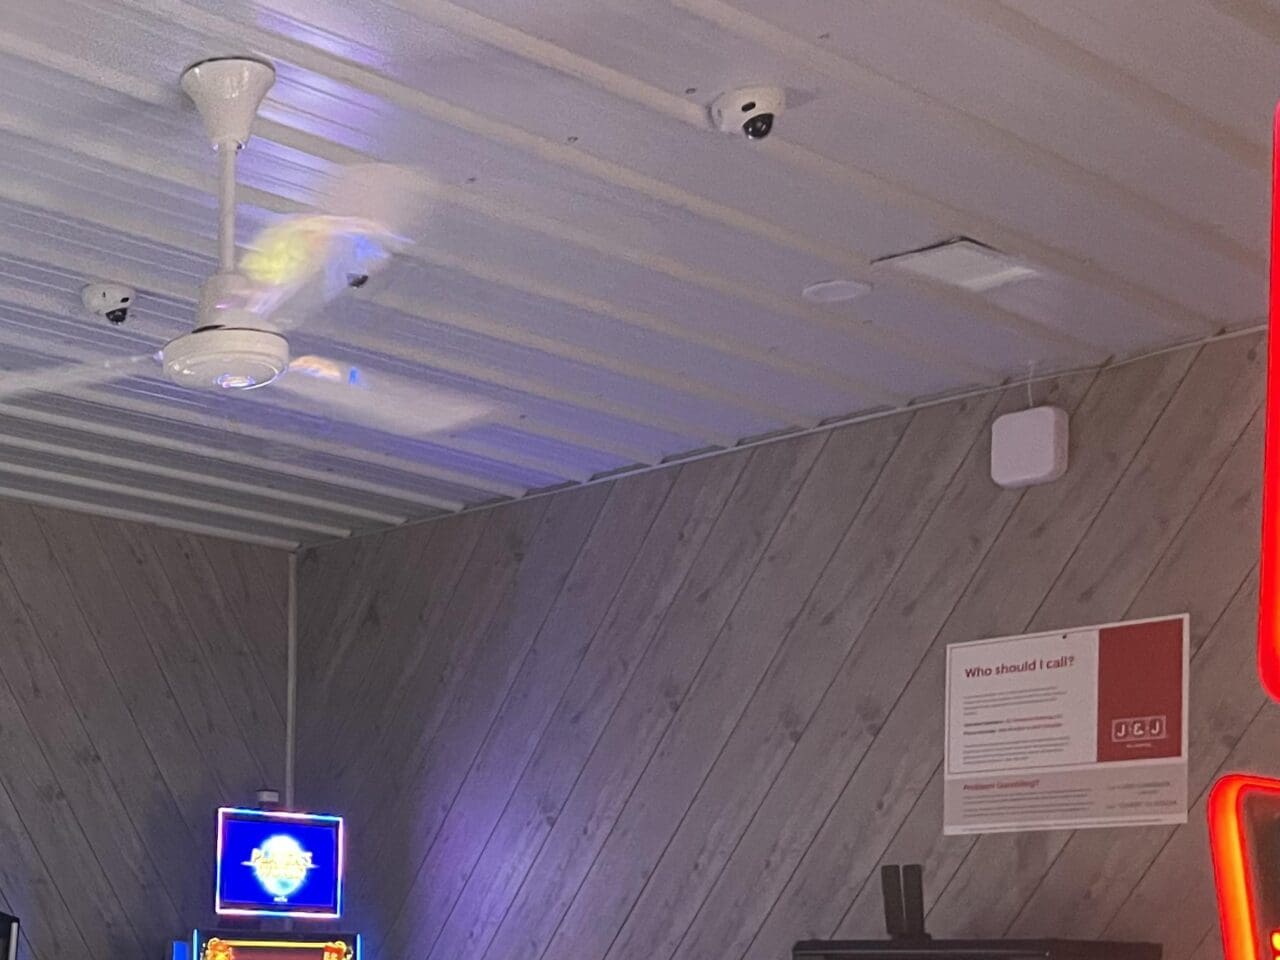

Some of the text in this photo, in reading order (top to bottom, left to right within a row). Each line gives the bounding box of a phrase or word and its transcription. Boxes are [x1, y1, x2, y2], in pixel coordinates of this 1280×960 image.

[964, 655, 1075, 679] Who should I call?
[1115, 718, 1162, 739] J&J
